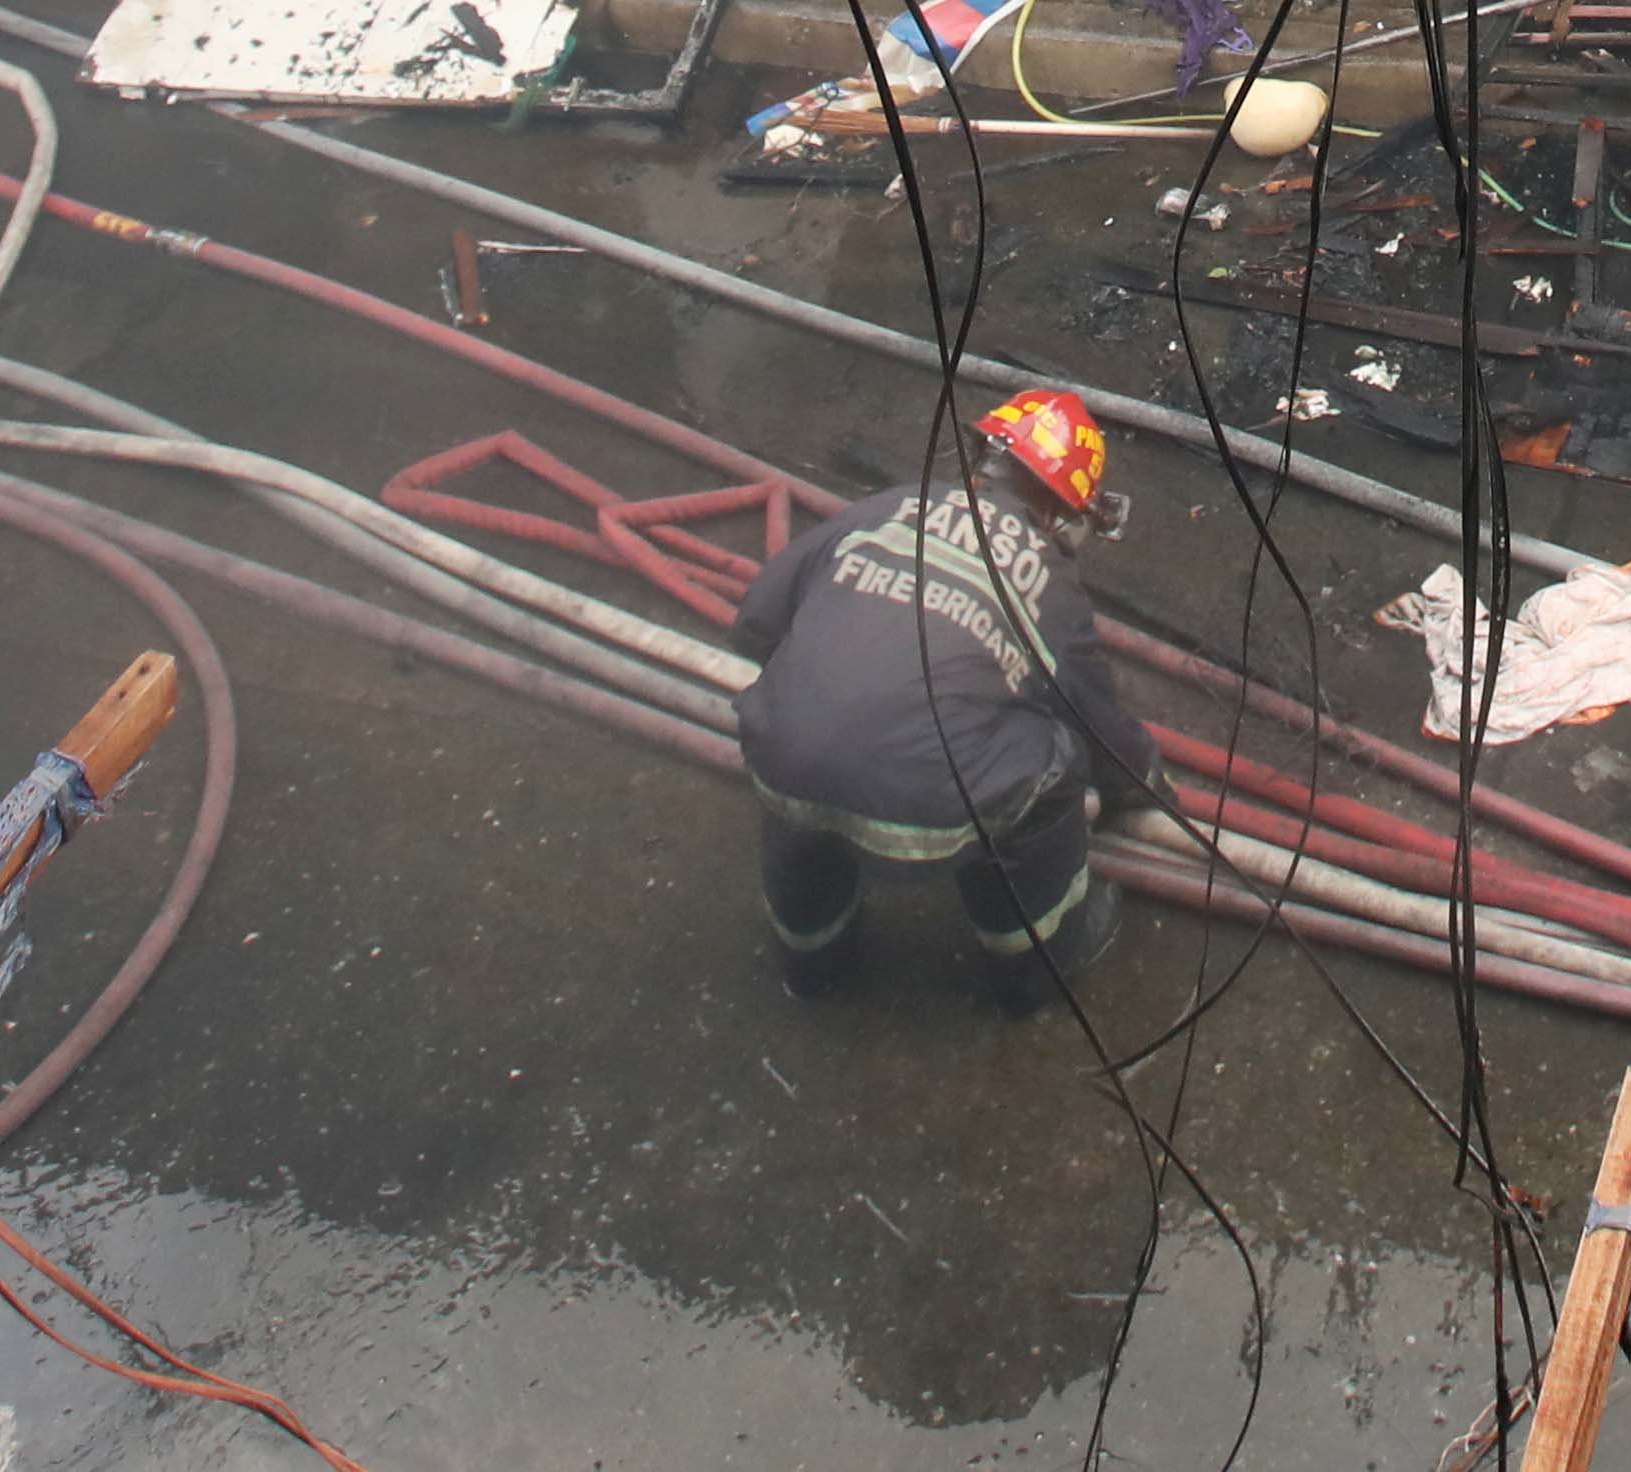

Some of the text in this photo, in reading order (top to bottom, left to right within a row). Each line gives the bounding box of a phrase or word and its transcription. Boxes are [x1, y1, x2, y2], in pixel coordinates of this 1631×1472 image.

[832, 554, 1031, 695] FIRE BRIGADE
[892, 497, 1051, 624] PANSOL
